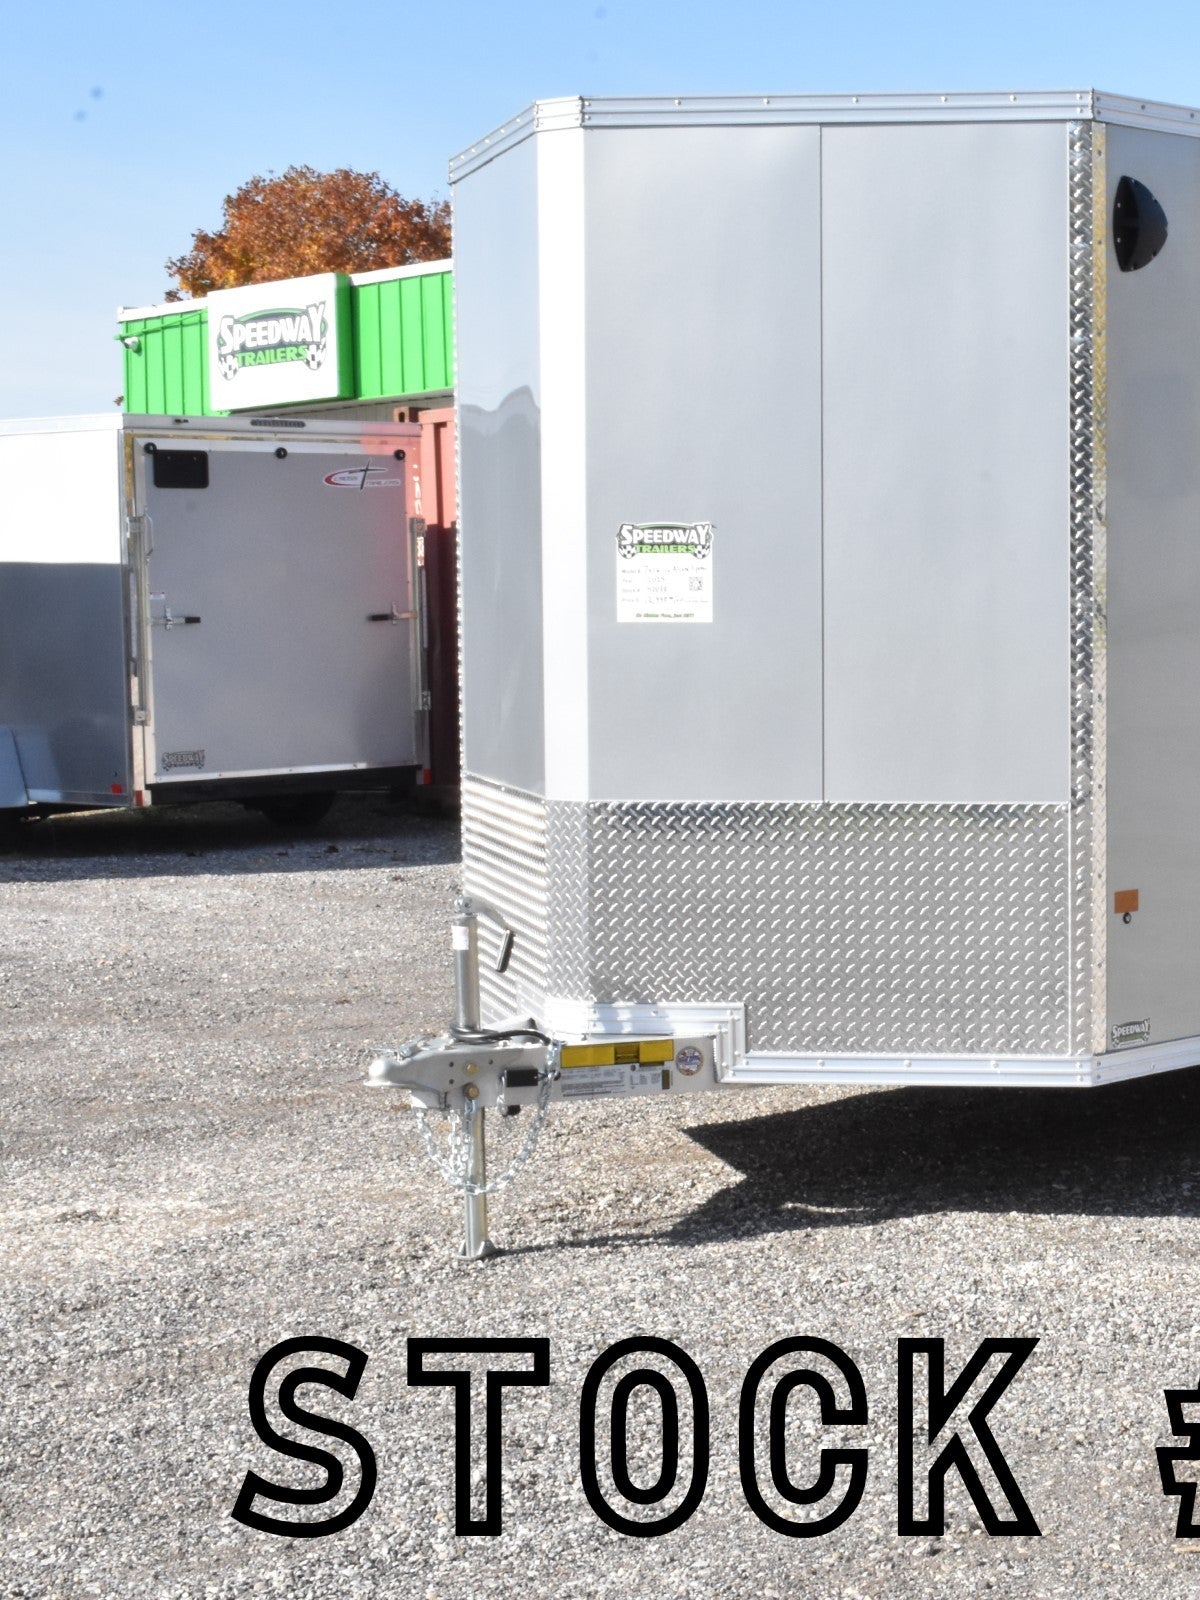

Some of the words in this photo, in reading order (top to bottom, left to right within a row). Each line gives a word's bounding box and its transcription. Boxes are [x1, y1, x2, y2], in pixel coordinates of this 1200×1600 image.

[219, 301, 325, 355] SPEEDWAY
[237, 345, 308, 367] TRAILERS
[620, 524, 710, 545] SPEEDWAY
[635, 544, 695, 553] TRAILERS
[1112, 1018, 1150, 1038] SPEEDWAY
